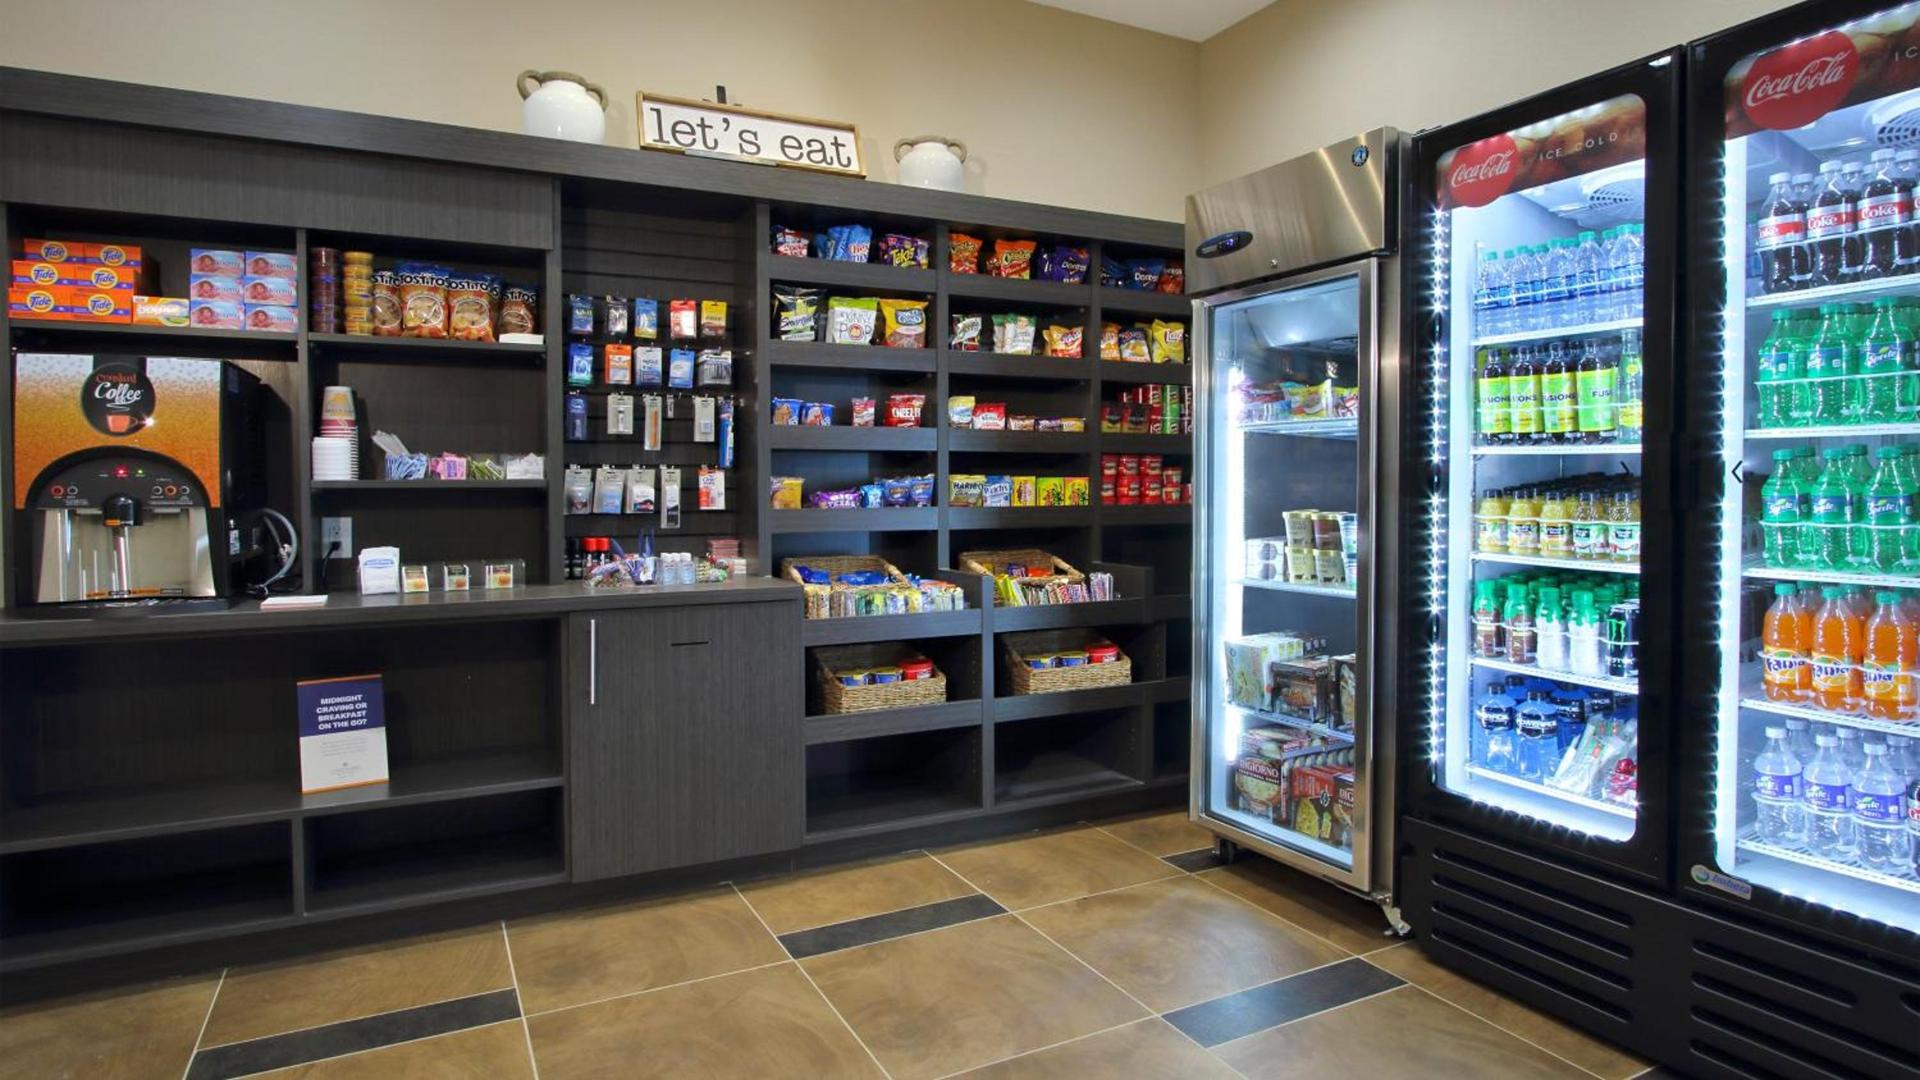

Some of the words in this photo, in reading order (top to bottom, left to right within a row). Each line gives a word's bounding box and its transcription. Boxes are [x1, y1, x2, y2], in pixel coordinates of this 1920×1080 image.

[1895, 45, 1919, 62] IC
[1746, 50, 1852, 107] Coca-Cola
[648, 107, 761, 156] let's
[780, 134, 852, 169] eat
[1539, 147, 1563, 161] ICE
[1575, 132, 1618, 152] COLD
[1451, 149, 1514, 188] Coca-Cola
[1862, 203, 1897, 221] Coke
[43, 246, 65, 258] Tide
[102, 250, 123, 262] Tide
[33, 268, 56, 281] Tide
[94, 272, 116, 285] Tide
[29, 294, 53, 308] Tide
[90, 299, 113, 312] Tide
[94, 381, 142, 404] Coffee
[320, 694, 363, 705] MIDNIGHT
[316, 704, 354, 714] CRAVING
[355, 702, 368, 710] OR
[318, 710, 367, 722] BREAKFAST
[318, 722, 332, 730] ON
[333, 720, 349, 729] THE
[350, 718, 368, 727] GO?
